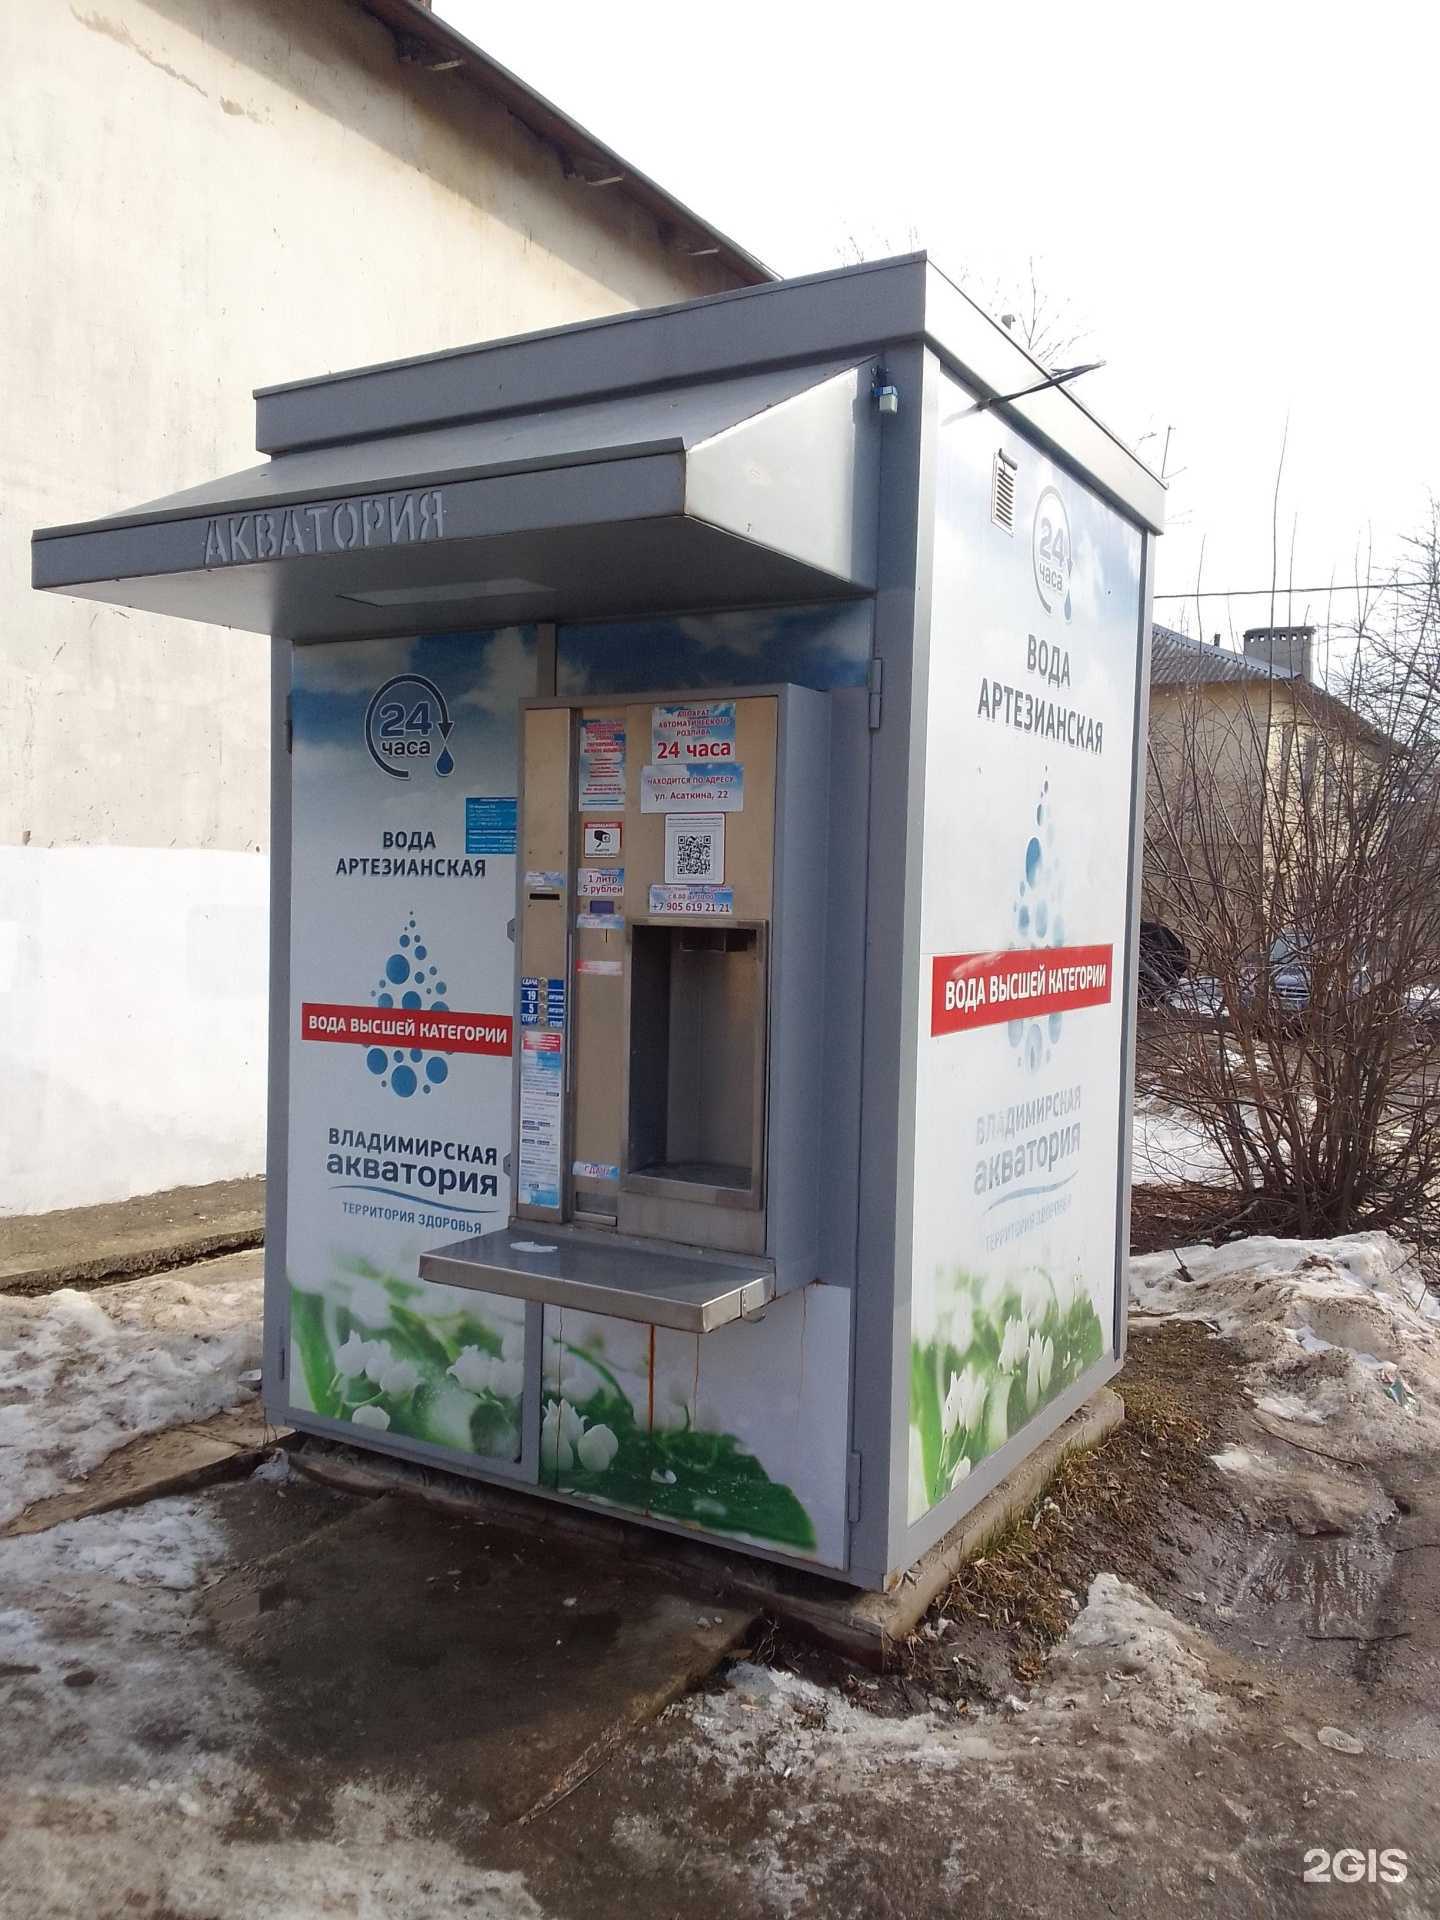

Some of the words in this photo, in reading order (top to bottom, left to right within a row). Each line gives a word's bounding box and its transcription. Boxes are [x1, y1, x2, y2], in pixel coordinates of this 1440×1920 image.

[204, 490, 444, 565] АКВАТОРИЯ
[1039, 517, 1065, 568] 24
[1039, 564, 1064, 592] часа
[1028, 633, 1070, 688] ВОДА
[380, 701, 433, 738] 24
[977, 678, 1103, 754] АРТЕЗИАНСКАЯ
[381, 740, 432, 757] часа
[657, 741, 680, 759] 24
[686, 742, 731, 757] часа
[647, 776, 691, 786] НАХОДИТСЯ
[655, 792, 668, 802] ул.
[670, 790, 714, 801] Асаткина,
[717, 790, 729, 799] 22
[383, 831, 437, 853] ВОДА
[336, 858, 486, 878] АРТЕЗИАНСКАЯ
[588, 875, 593, 883] 1
[595, 876, 617, 885] литр
[583, 885, 588, 893] 5
[653, 903, 664, 911] +7
[666, 903, 682, 911] 905
[685, 903, 702, 912] 619
[705, 903, 715, 912] 21
[720, 904, 729, 912] 21
[527, 991, 536, 1000] 19
[945, 976, 986, 1014] ВОДА
[989, 964, 1046, 1005] ВЫСШЕЙ
[1048, 963, 1106, 994] КАТЕГОРИИ
[528, 1003, 534, 1013] 5
[308, 1015, 346, 1034] ВОДА
[350, 1019, 415, 1037] ВЫСШЕЙ
[420, 1023, 507, 1043] КАТЕГОРИИ
[329, 1127, 498, 1167] ВЛАДИМИРСКАЯ
[974, 1121, 1081, 1196] акватория
[326, 1152, 498, 1197] акватория
[342, 1201, 415, 1224] ТЕРРИТОРИЯ
[418, 1214, 482, 1234] ЗДОРОВЬЯ
